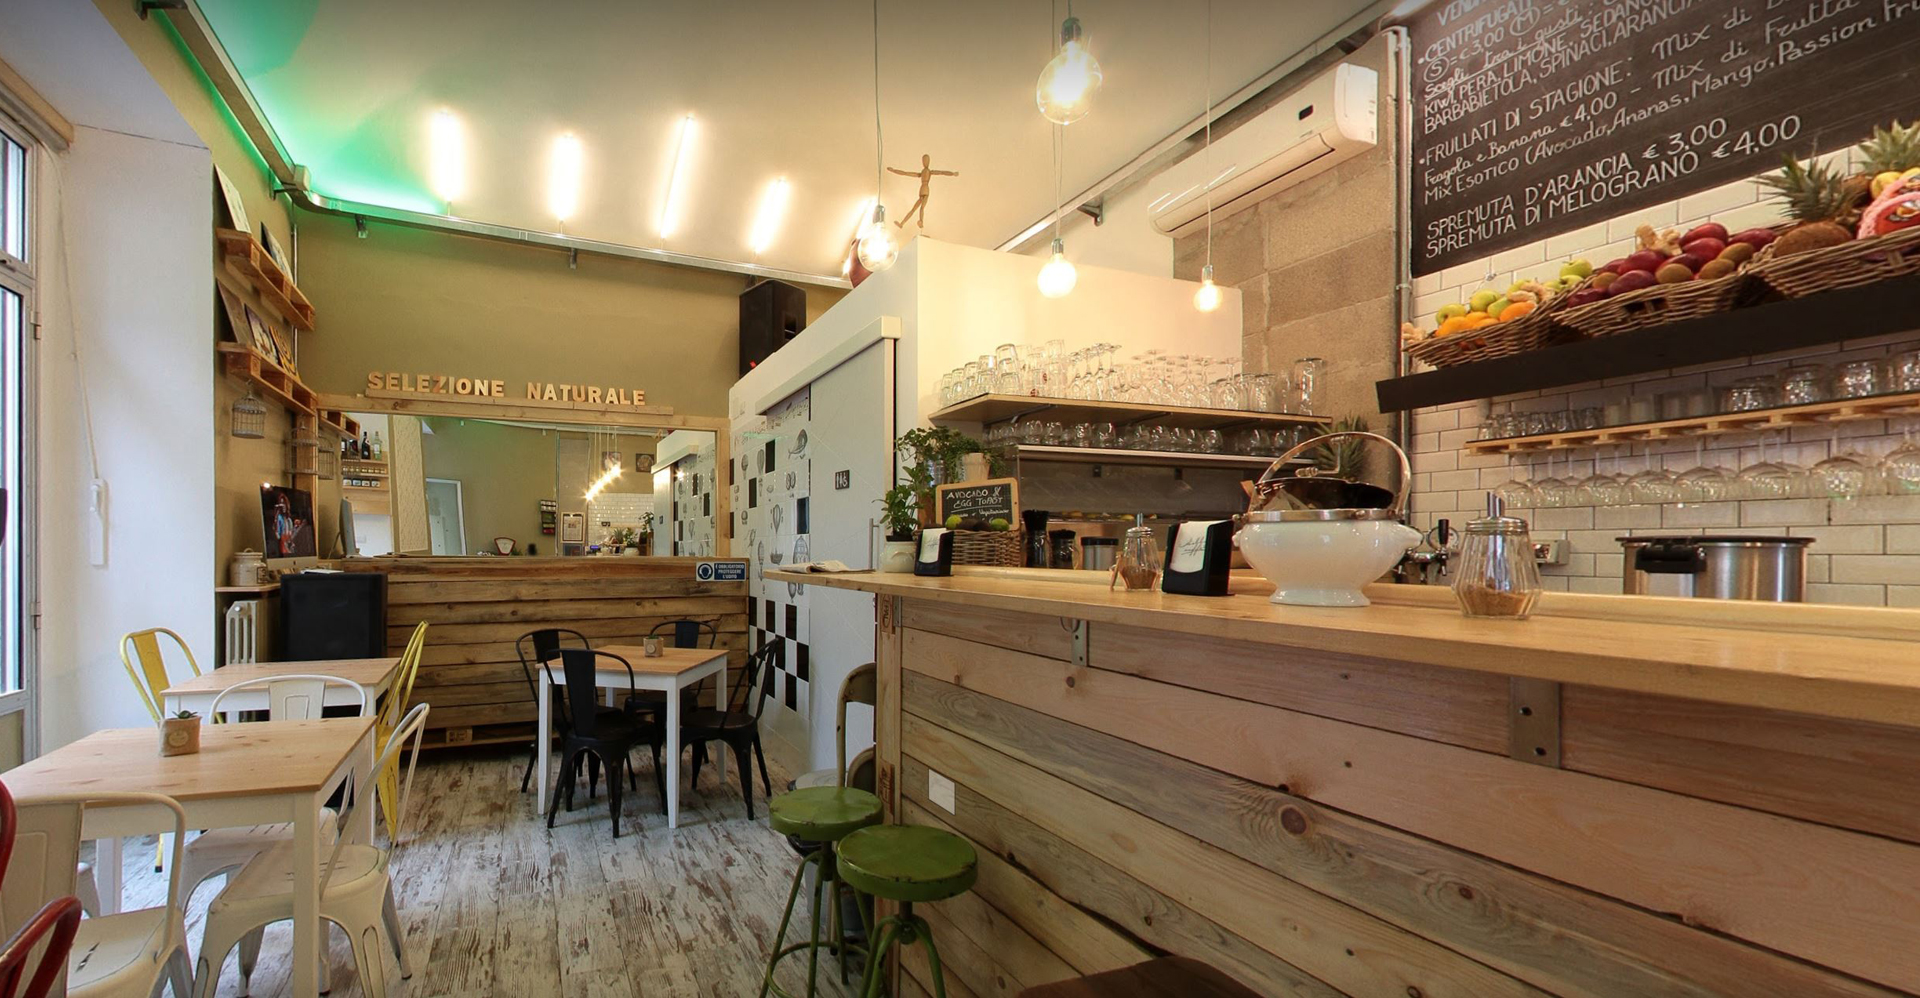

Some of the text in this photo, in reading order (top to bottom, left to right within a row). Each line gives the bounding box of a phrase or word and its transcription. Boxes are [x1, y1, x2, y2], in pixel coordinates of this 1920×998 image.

[1425, 156, 1474, 187] Fragola
[1488, 125, 1557, 160] Banana
[1652, 60, 1704, 89] Mix
[1720, 41, 1749, 63] di
[1765, 0, 1861, 44] Frutta
[1427, 7, 1752, 165] FRULLATI DI STAGIONE: Mix di
[1484, 51, 1514, 69] tra
[1425, 185, 1453, 205] Mix
[1779, 18, 1876, 65] Passion
[1426, 214, 1517, 258] SPREMUTA
[1525, 206, 1541, 226] DI
[1550, 150, 1699, 217] MELOGRANO
[1427, 194, 1514, 239] SPREMUTA
[1525, 152, 1632, 206] D'ARANCIA
[367, 371, 646, 406] SELEZIONE NATURALE
[946, 489, 989, 499] AVOCADO
[953, 500, 972, 509] EGG
